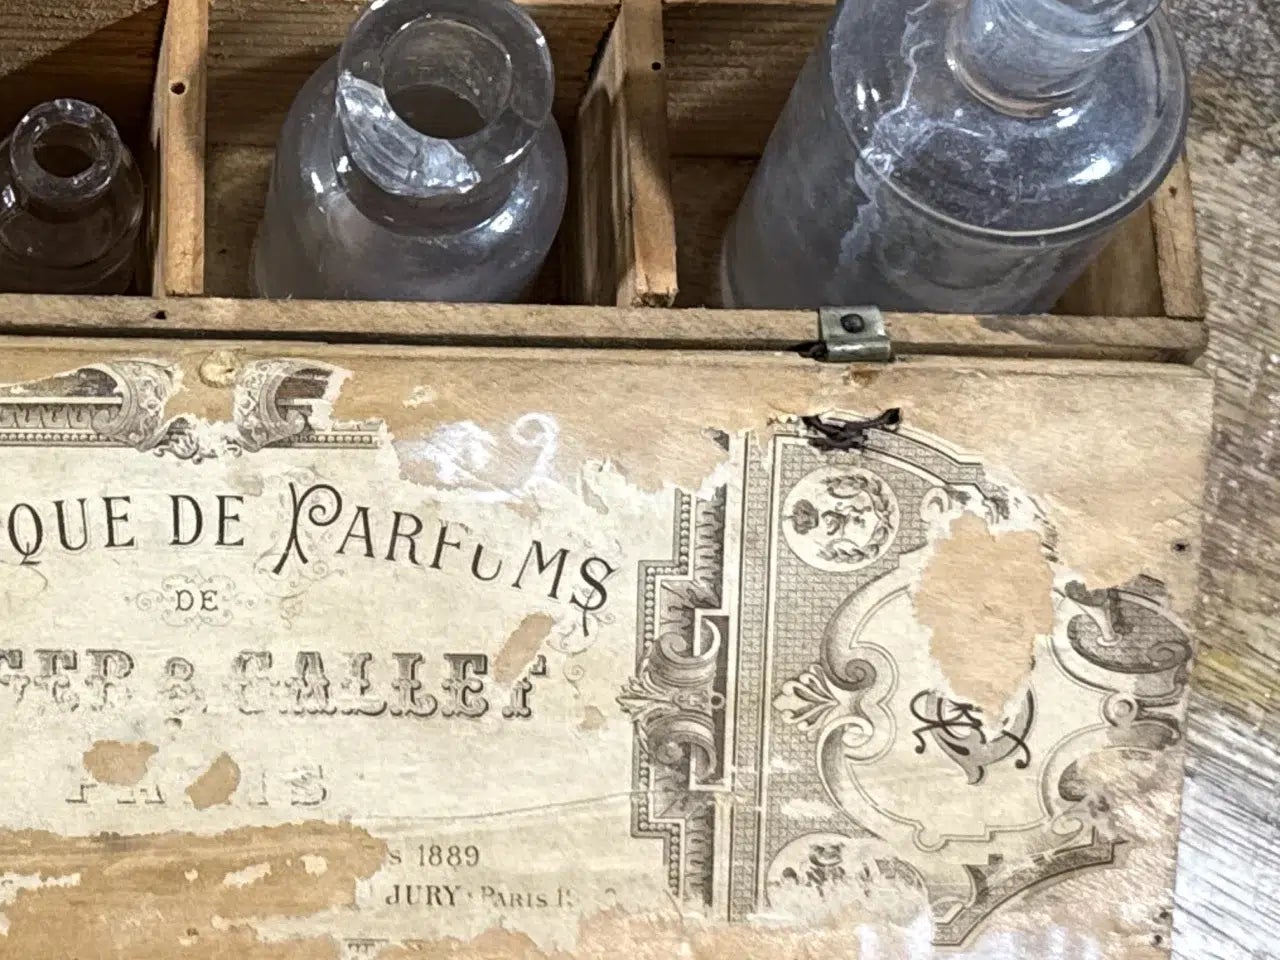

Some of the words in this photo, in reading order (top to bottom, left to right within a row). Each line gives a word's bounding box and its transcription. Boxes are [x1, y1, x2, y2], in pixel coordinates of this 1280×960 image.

[169, 494, 246, 547] DE
[271, 481, 620, 638] PARFUMS
[174, 589, 220, 613] DE
[418, 843, 481, 868] 1889
[385, 884, 462, 907] JURY
